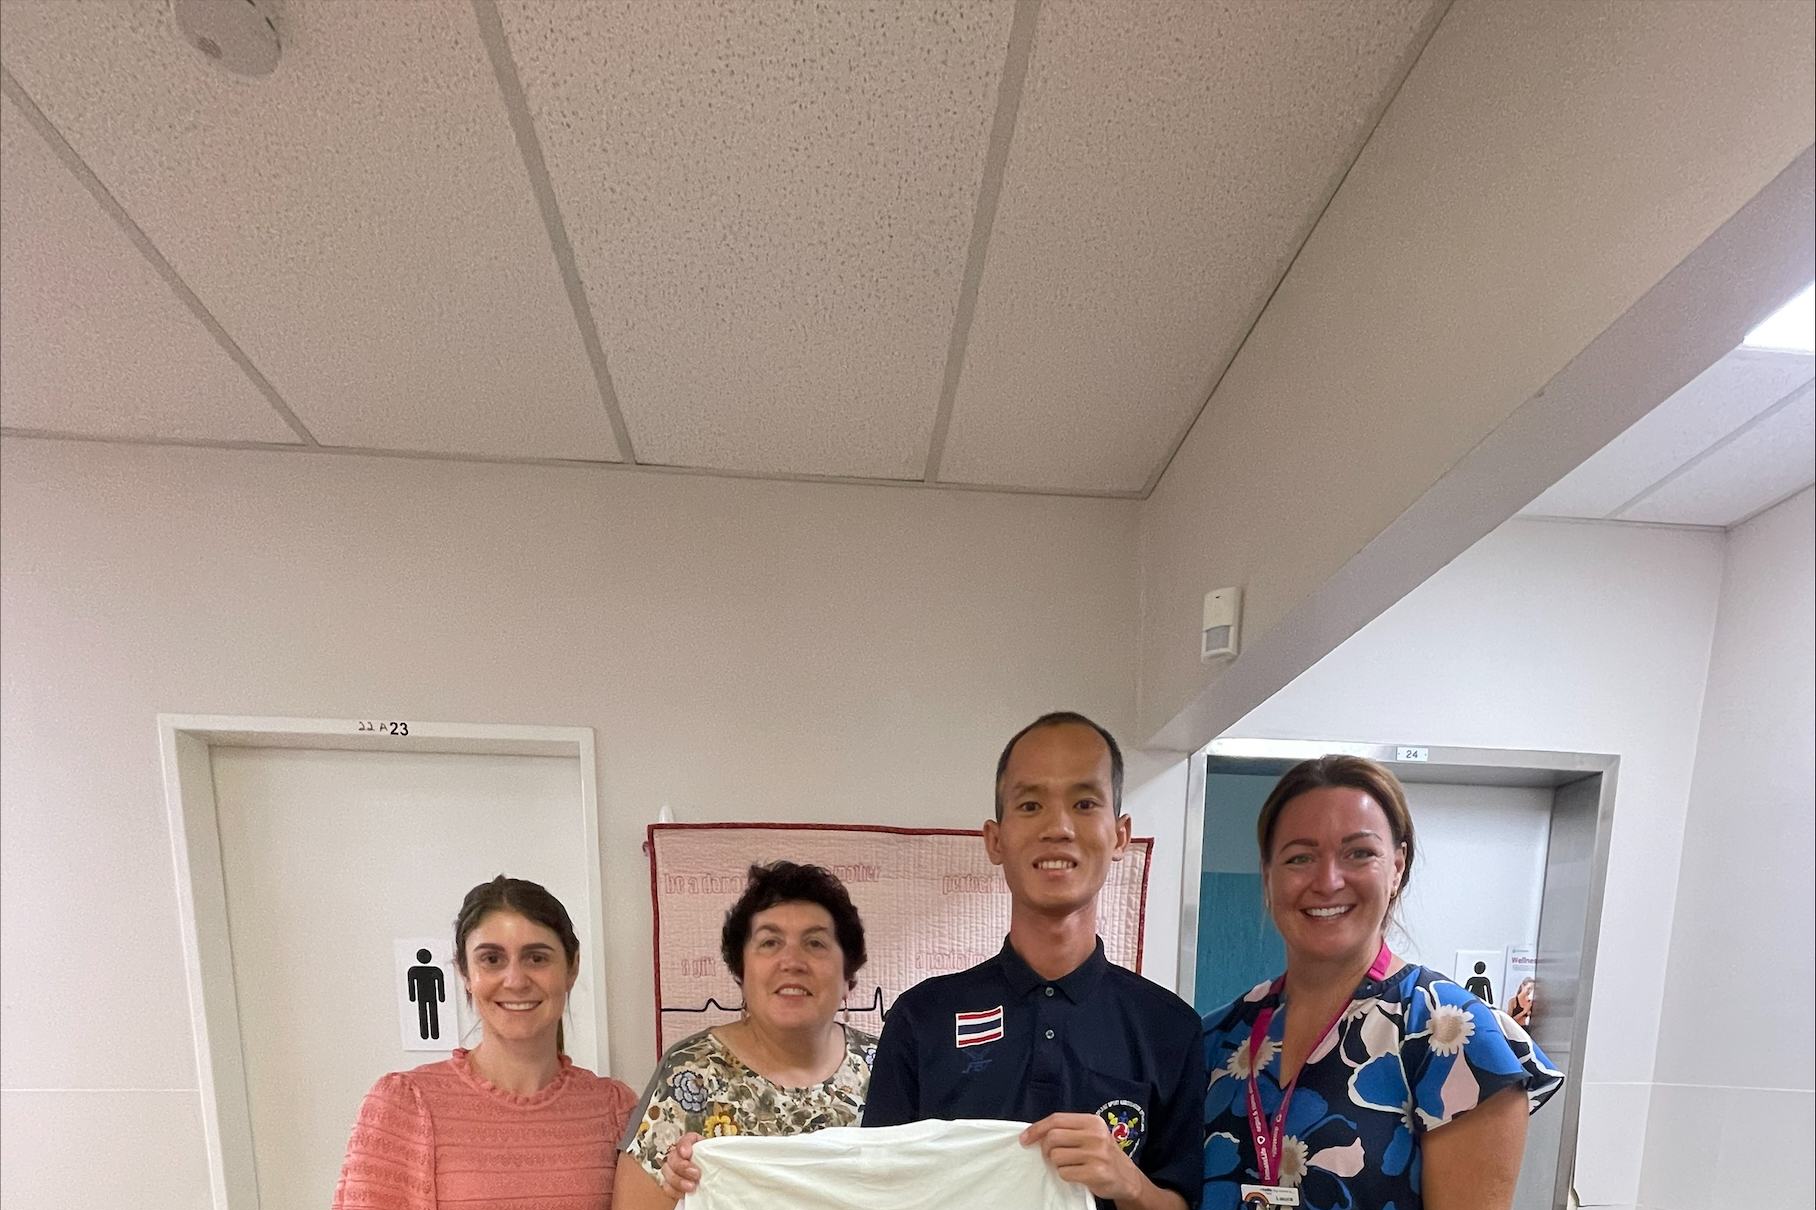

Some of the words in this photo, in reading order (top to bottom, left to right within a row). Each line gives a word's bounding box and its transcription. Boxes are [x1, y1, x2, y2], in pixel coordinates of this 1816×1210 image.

[389, 721, 409, 736] 23
[1406, 749, 1418, 759] 24
[664, 873, 684, 894] be
[687, 876, 700, 894] a
[942, 874, 993, 895] perfect
[681, 958, 690, 976] a
[692, 955, 717, 978] gift
[915, 953, 925, 969] a
